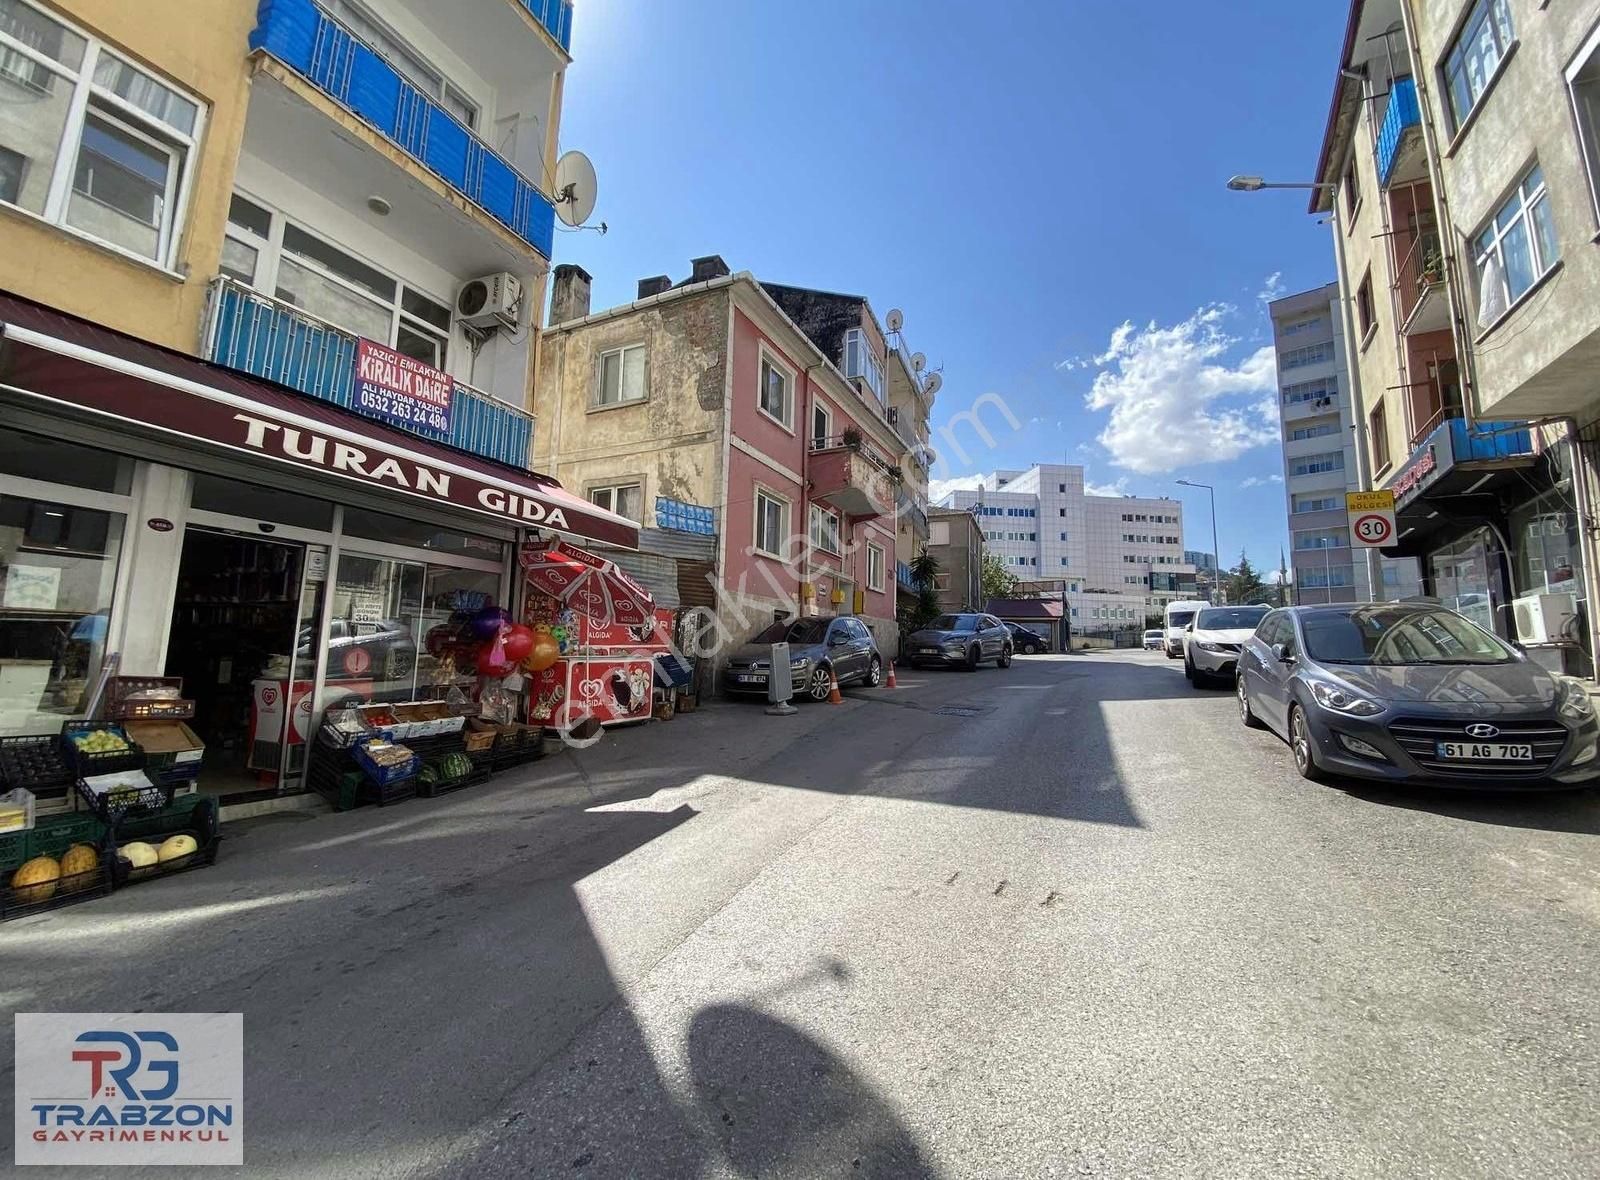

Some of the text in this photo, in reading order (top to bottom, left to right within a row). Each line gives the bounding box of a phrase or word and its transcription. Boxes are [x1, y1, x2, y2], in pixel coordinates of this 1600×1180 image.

[367, 346, 447, 383] YAZICI EMLAKTAN
[361, 391, 389, 412] 0532
[391, 401, 411, 419] 263
[413, 407, 426, 424] 24
[380, 388, 415, 406] HAYDAR
[416, 400, 443, 415] YAZICI
[234, 414, 570, 530] TURAN GIDA
[1361, 521, 1384, 536] 30
[565, 549, 596, 565] ALGIDA
[588, 631, 611, 639] ALGIDA
[578, 700, 603, 708] ALGIDA
[1445, 744, 1530, 758] 61 AG 702
